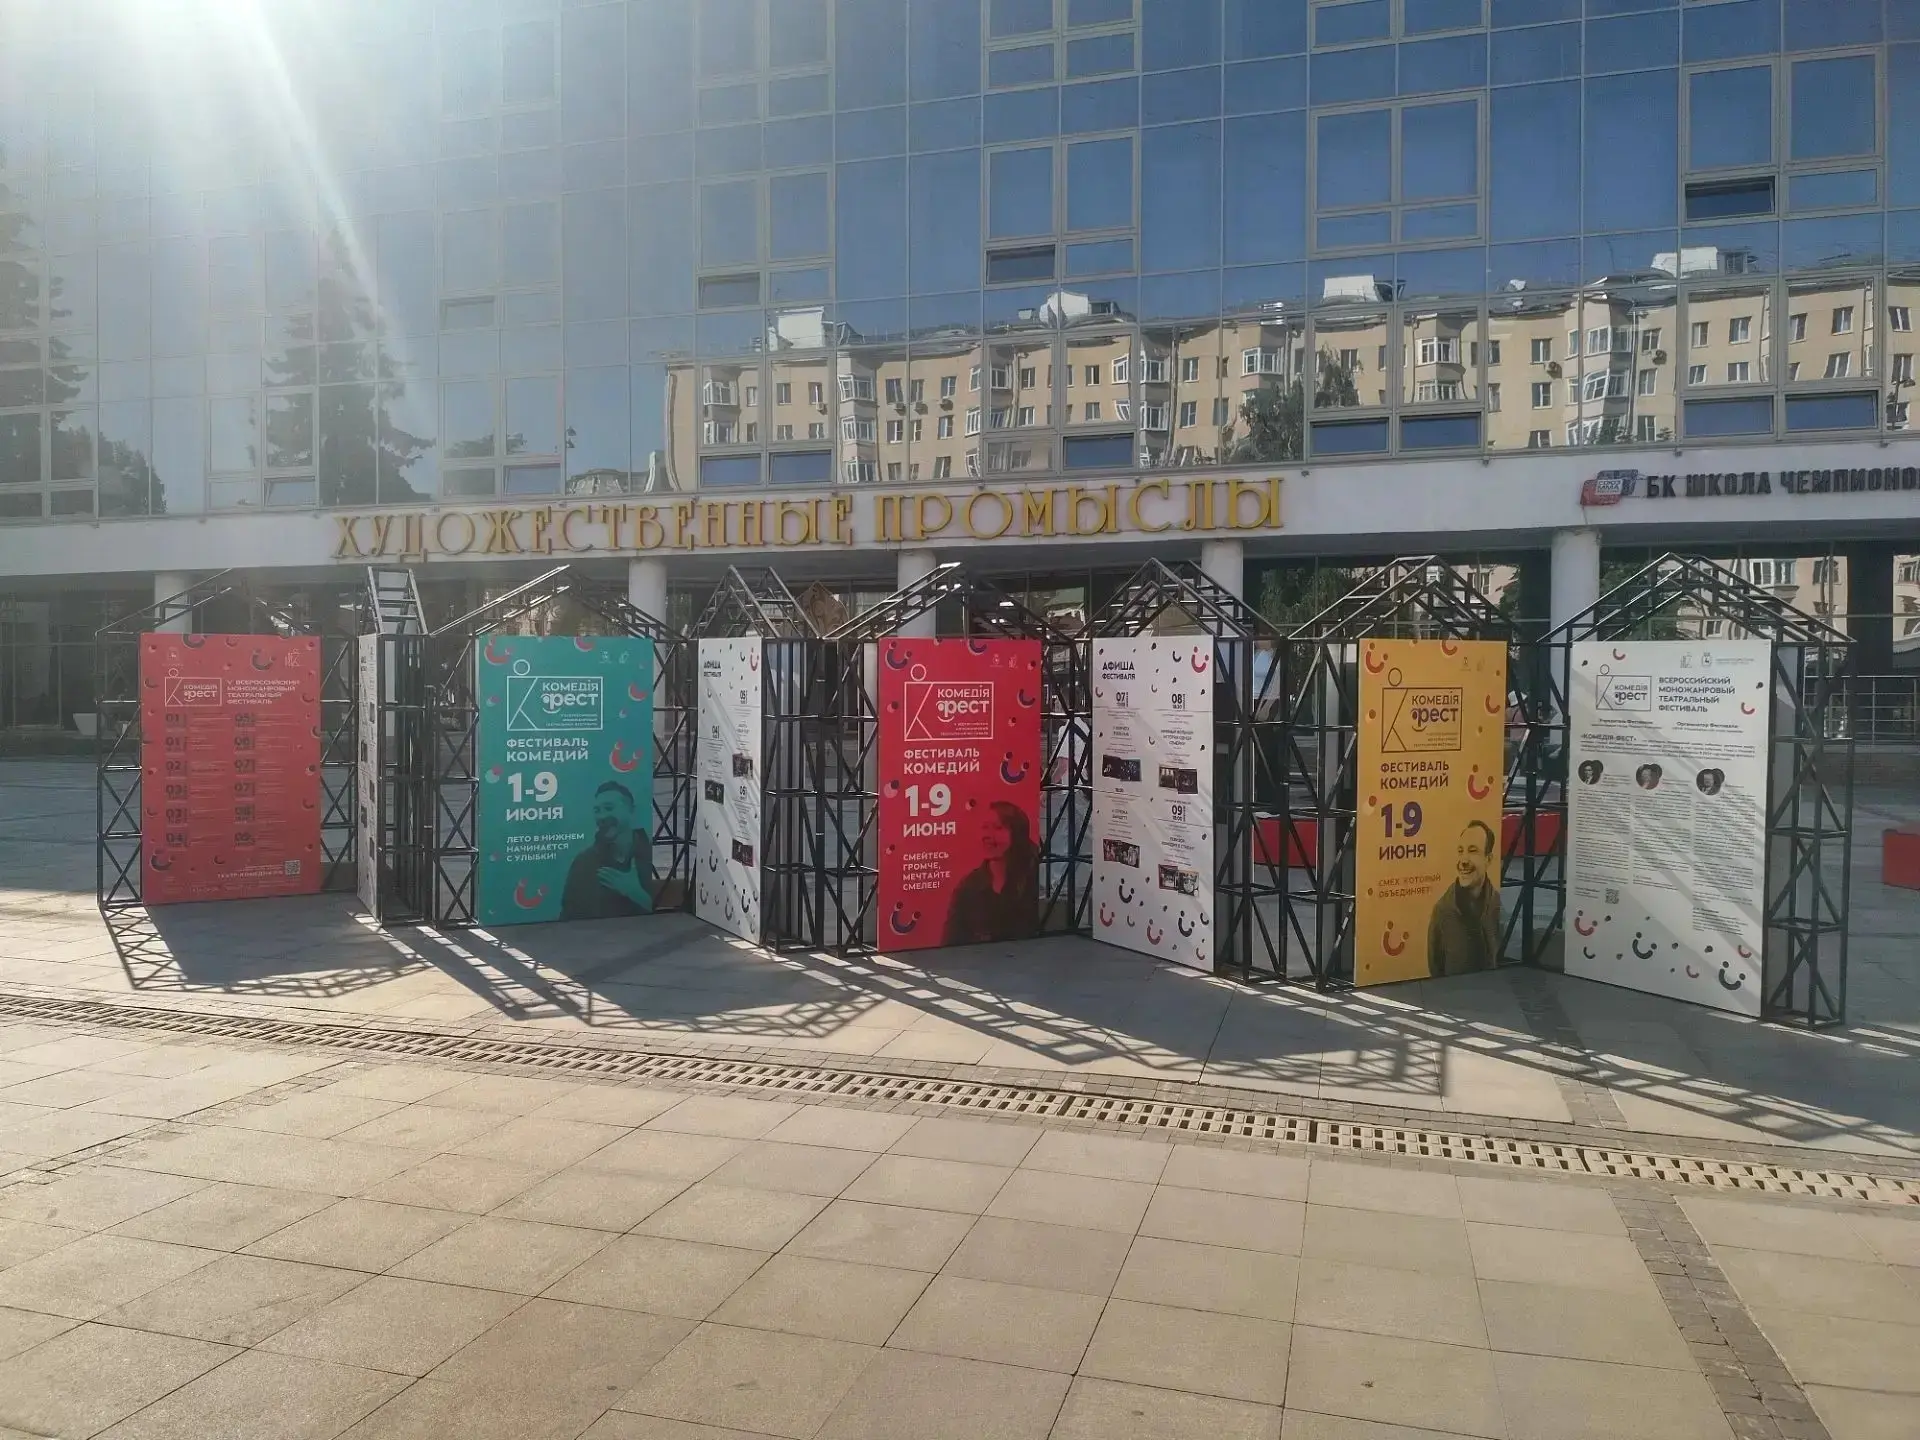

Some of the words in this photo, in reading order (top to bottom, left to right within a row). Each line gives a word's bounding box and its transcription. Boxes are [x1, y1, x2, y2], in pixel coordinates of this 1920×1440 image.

[1647, 475, 1676, 498] БК
[1686, 472, 1772, 497] ШКОЛА
[1780, 466, 1920, 494] ЧЕМПИОНО
[330, 494, 853, 564] ХУДОЖЕСТВЕННЫЕ
[874, 477, 1284, 542] ПРОМЫСЛЫ
[1102, 662, 1135, 671] АФИША
[1658, 676, 1731, 684] ВСЕРОССИЙСКИЙ
[1658, 686, 1736, 694] МОНОЖАНРОВЫЙ
[1116, 692, 1125, 702] 07
[1171, 694, 1182, 704] 08
[1658, 695, 1720, 704] ТЕАТРАЛЬНЫЙ
[507, 738, 589, 748] ФЕСТИВАЛЬ
[507, 748, 589, 763] КОМЕДИЙ
[904, 748, 980, 759] ФЕСТИВАЛЬ
[904, 759, 980, 775] КОМЕДИЙ
[1380, 760, 1449, 772] ФЕСТИВАЛЬ
[1380, 772, 1449, 790] КОМЕДИЙ
[508, 772, 558, 803] 1-9
[905, 783, 951, 816] 1-9
[507, 807, 563, 821] ИЮНЯ
[1171, 805, 1182, 816] 09
[1381, 801, 1423, 838] 1-9
[903, 821, 956, 837] ИЮНЯ
[507, 836, 532, 844] ЛЕТО
[542, 833, 585, 841] НИЖНЕМ
[507, 843, 569, 853] НАЧИНАЕТСЯ
[1379, 844, 1427, 860] ИЮНЯ
[514, 853, 557, 861] УЛЫБКИ!
[903, 851, 949, 861] СМЕЙТЕСЬ
[903, 862, 940, 871] ГРОМЧЕ,
[903, 871, 951, 881] МЕЧТАЙТЕ
[903, 882, 940, 890] СМЕЛЕЕ!
